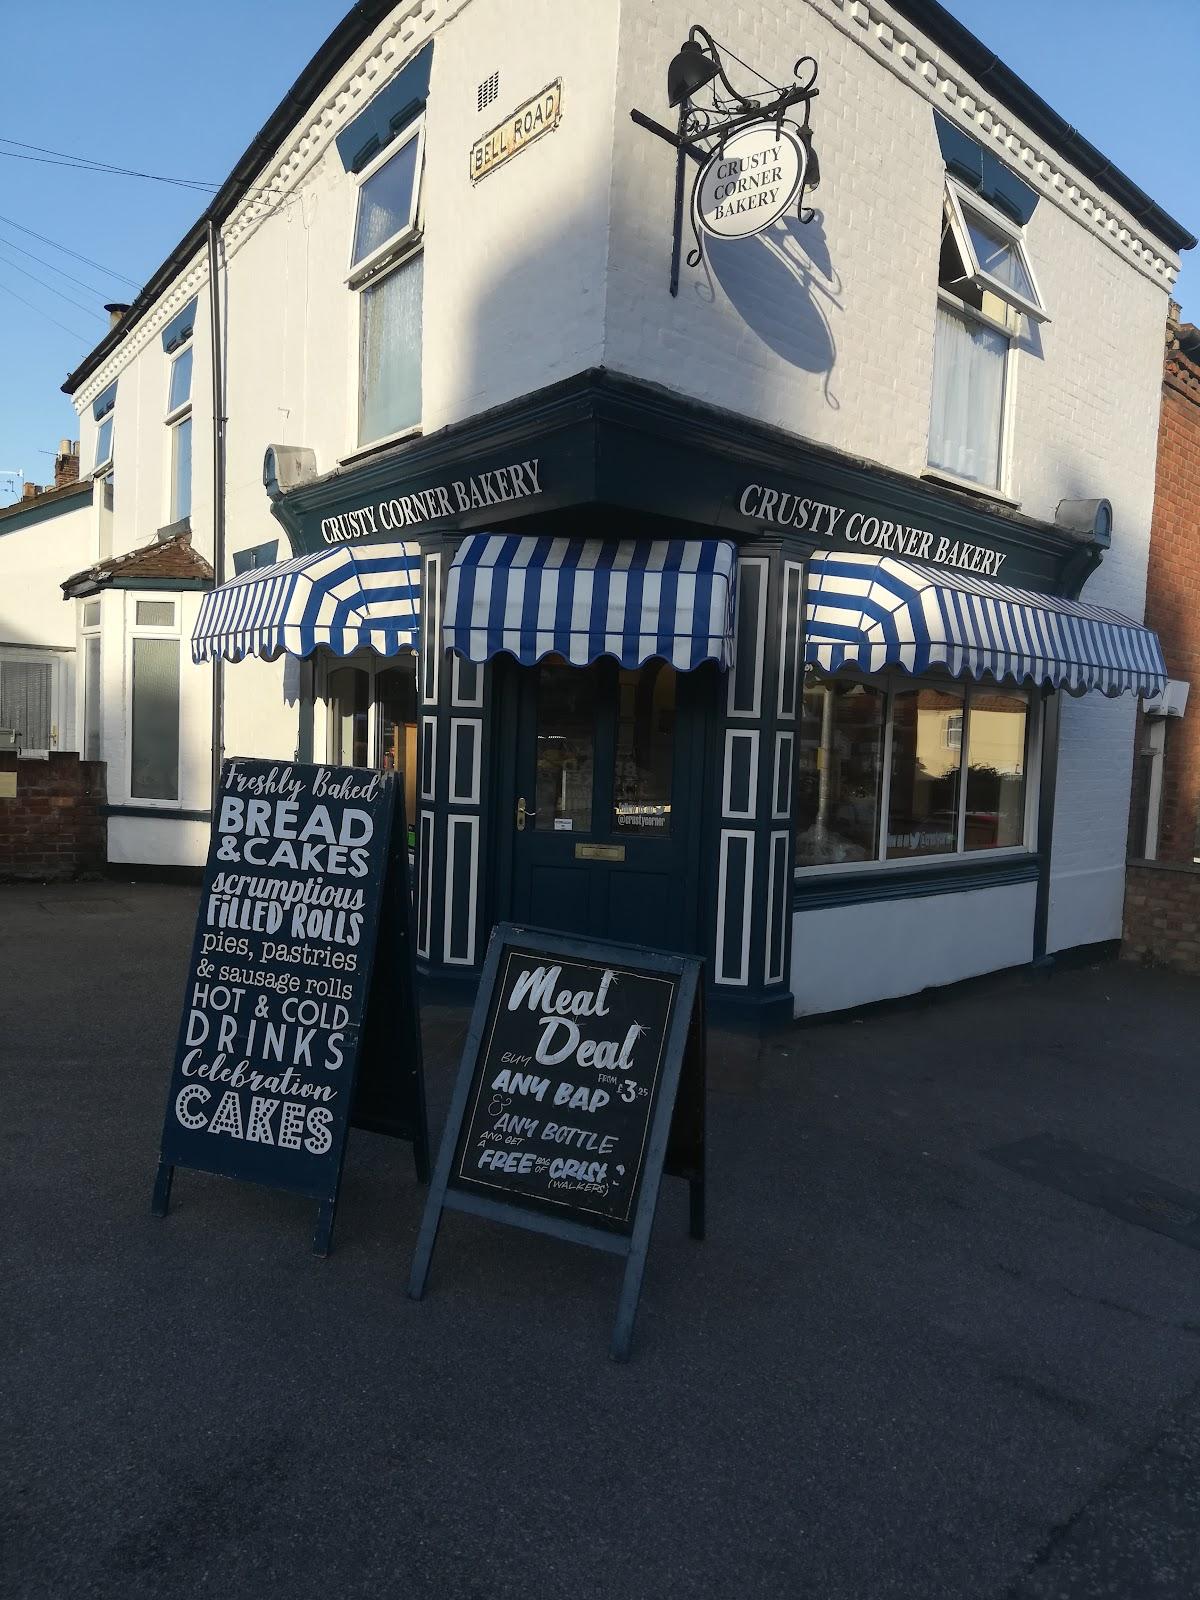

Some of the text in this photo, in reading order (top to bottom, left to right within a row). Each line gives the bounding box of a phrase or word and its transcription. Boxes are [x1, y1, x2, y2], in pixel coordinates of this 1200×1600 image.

[475, 94, 554, 171] BELL ROAD
[714, 166, 783, 200] CORNER
[716, 146, 782, 179] CRUSTY
[714, 188, 779, 220] BAKERY
[321, 459, 543, 544] CRUSTY CORNER BAKERY
[739, 484, 1007, 577] CRUSTY CORNER BAKERY
[224, 762, 381, 802] Freshly Baked
[218, 795, 374, 847] BREAD
[211, 872, 365, 911] scrumptious
[291, 904, 364, 946] ROLLS
[200, 931, 358, 971] pies, pastries
[197, 958, 353, 1000] & sausage rolls
[507, 965, 613, 1017] Meal
[192, 982, 350, 1030] HOT & COLD
[185, 1010, 345, 1071] DRINKS
[535, 1016, 642, 1070] Deal
[181, 1048, 338, 1102] Celebration
[491, 1069, 610, 1112] ANY BAP
[175, 1083, 334, 1155] CAKES
[480, 1130, 525, 1146] AND GET
[493, 1113, 619, 1155] ANY BOTTLE
[477, 1139, 487, 1148] A
[477, 1149, 537, 1174] FREE
